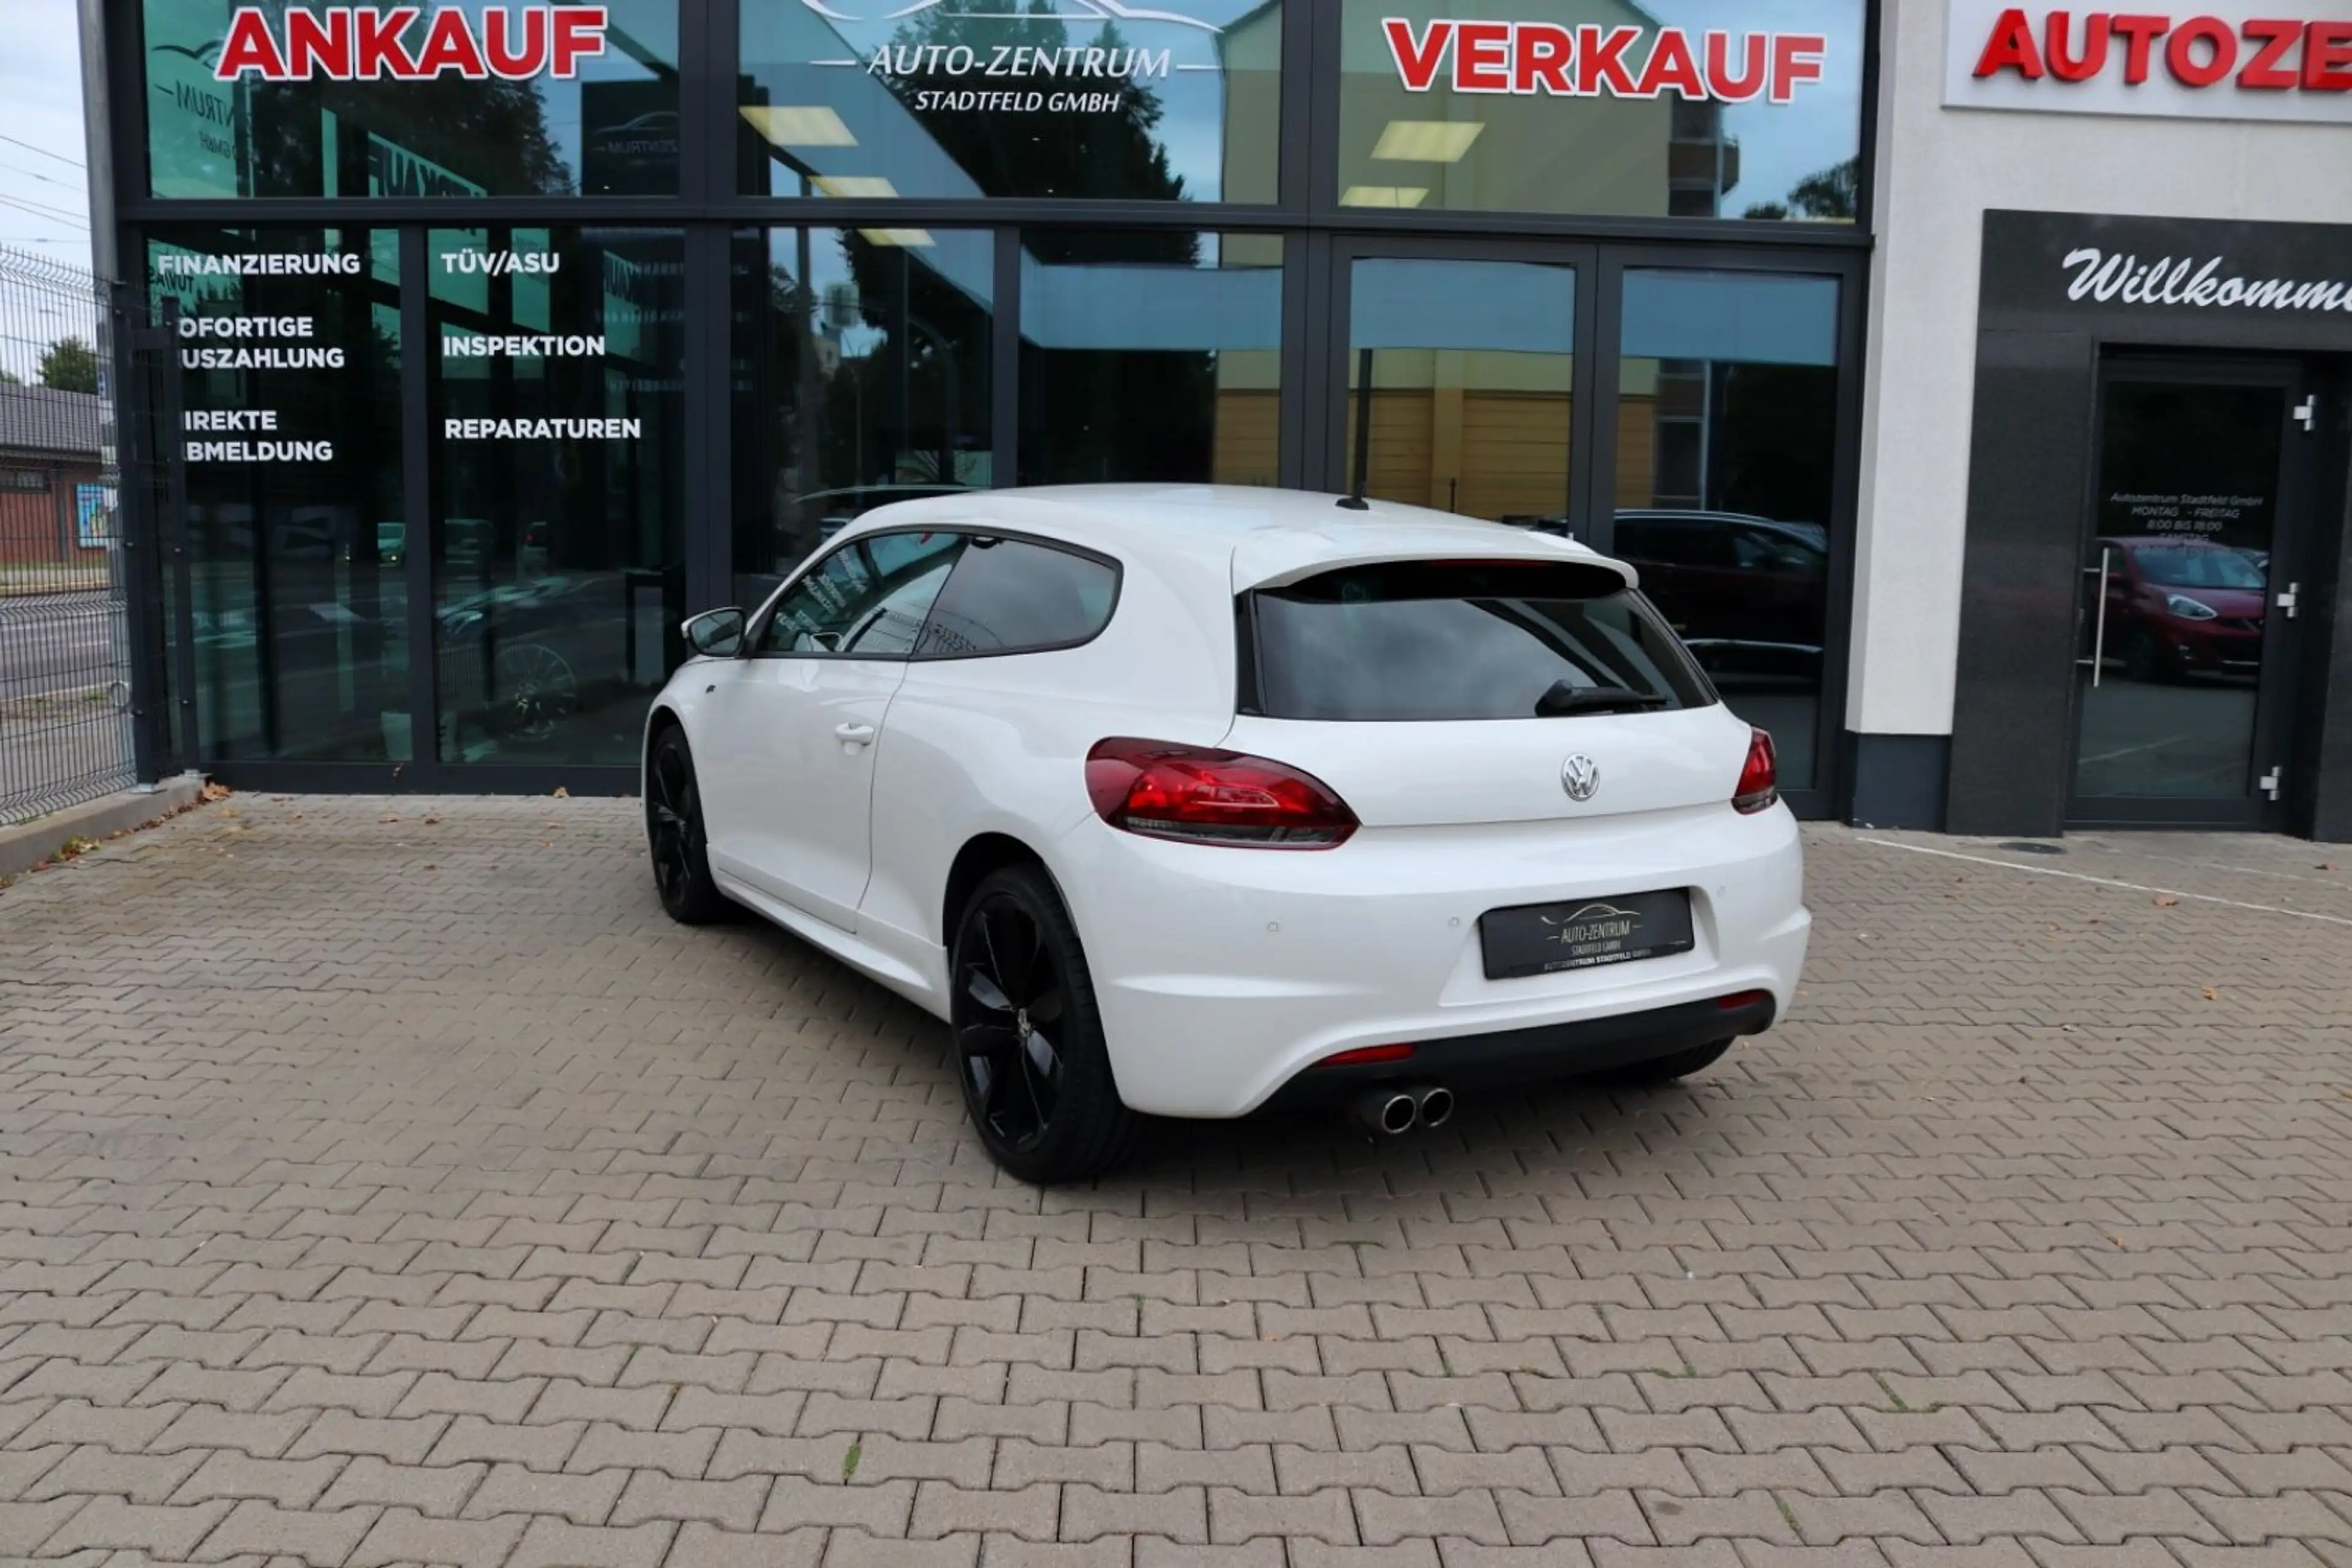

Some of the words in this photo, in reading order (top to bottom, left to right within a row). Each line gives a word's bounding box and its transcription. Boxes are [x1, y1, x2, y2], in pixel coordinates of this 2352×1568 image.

[215, 5, 607, 81] ANKAUF
[1972, 8, 2352, 91] AUTOZE
[866, 44, 1171, 80] AUTO-ZENTRUM
[1382, 17, 1826, 104] VERKAUF
[914, 90, 1043, 113] STADTFELD
[1047, 91, 1120, 114] GMBH
[158, 253, 361, 275] FINANZIERUNG
[440, 249, 560, 276] TÜV/ASU
[179, 316, 314, 338] OFORTIGE
[443, 335, 606, 357] INSPEKTION
[181, 347, 345, 369] USZAHLUNG
[184, 410, 277, 432] IREKTE
[445, 418, 641, 440] REPARATUREN
[186, 440, 333, 462] BMELDUNG
[2131, 506, 2179, 516] MONTAG
[1561, 920, 1630, 944] AUTO-ZENTRUM
